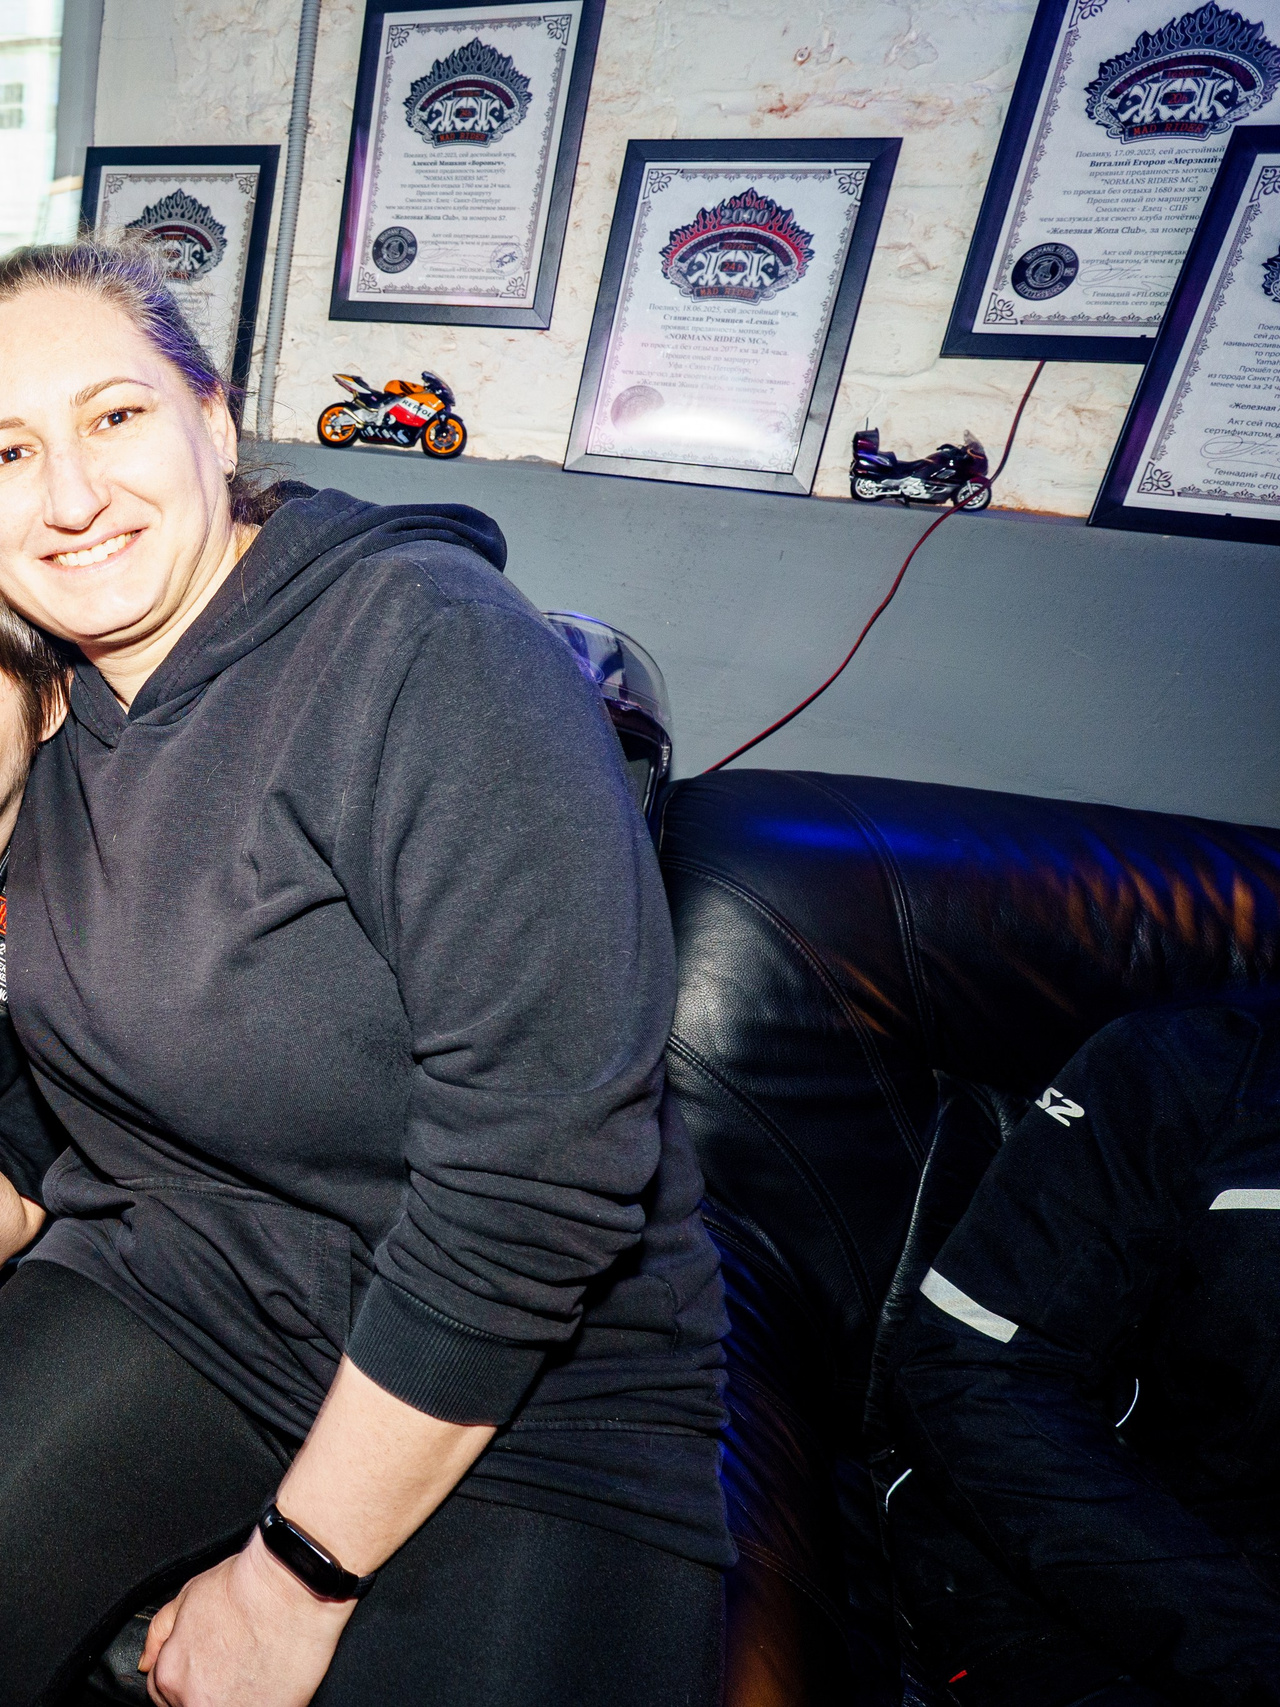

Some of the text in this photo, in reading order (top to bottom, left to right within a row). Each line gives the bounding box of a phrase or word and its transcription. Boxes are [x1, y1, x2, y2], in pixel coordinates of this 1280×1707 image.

[1133, 123, 1204, 135] MAD RIDER
[1158, 148, 1175, 156] сей
[1089, 159, 1131, 168] Виталий
[1132, 158, 1166, 168] Егоров
[1089, 167, 1219, 179] проявил преданность мотоклу
[1147, 177, 1178, 185] RIDERS
[1109, 187, 1120, 195] без
[1122, 188, 1152, 196] отдыха
[1154, 186, 1173, 194] 1680
[1159, 196, 1201, 204] маршруту
[1139, 214, 1163, 222] клуба
[1094, 227, 1120, 235] Жопа
[700, 286, 718, 296] MAD
[1132, 290, 1170, 298] «FILOSOF
[714, 335, 746, 343] RIDERS
[1229, 402, 1276, 411] «Железная
[1214, 468, 1258, 478] Геннадий
[1202, 478, 1255, 488] основатель
